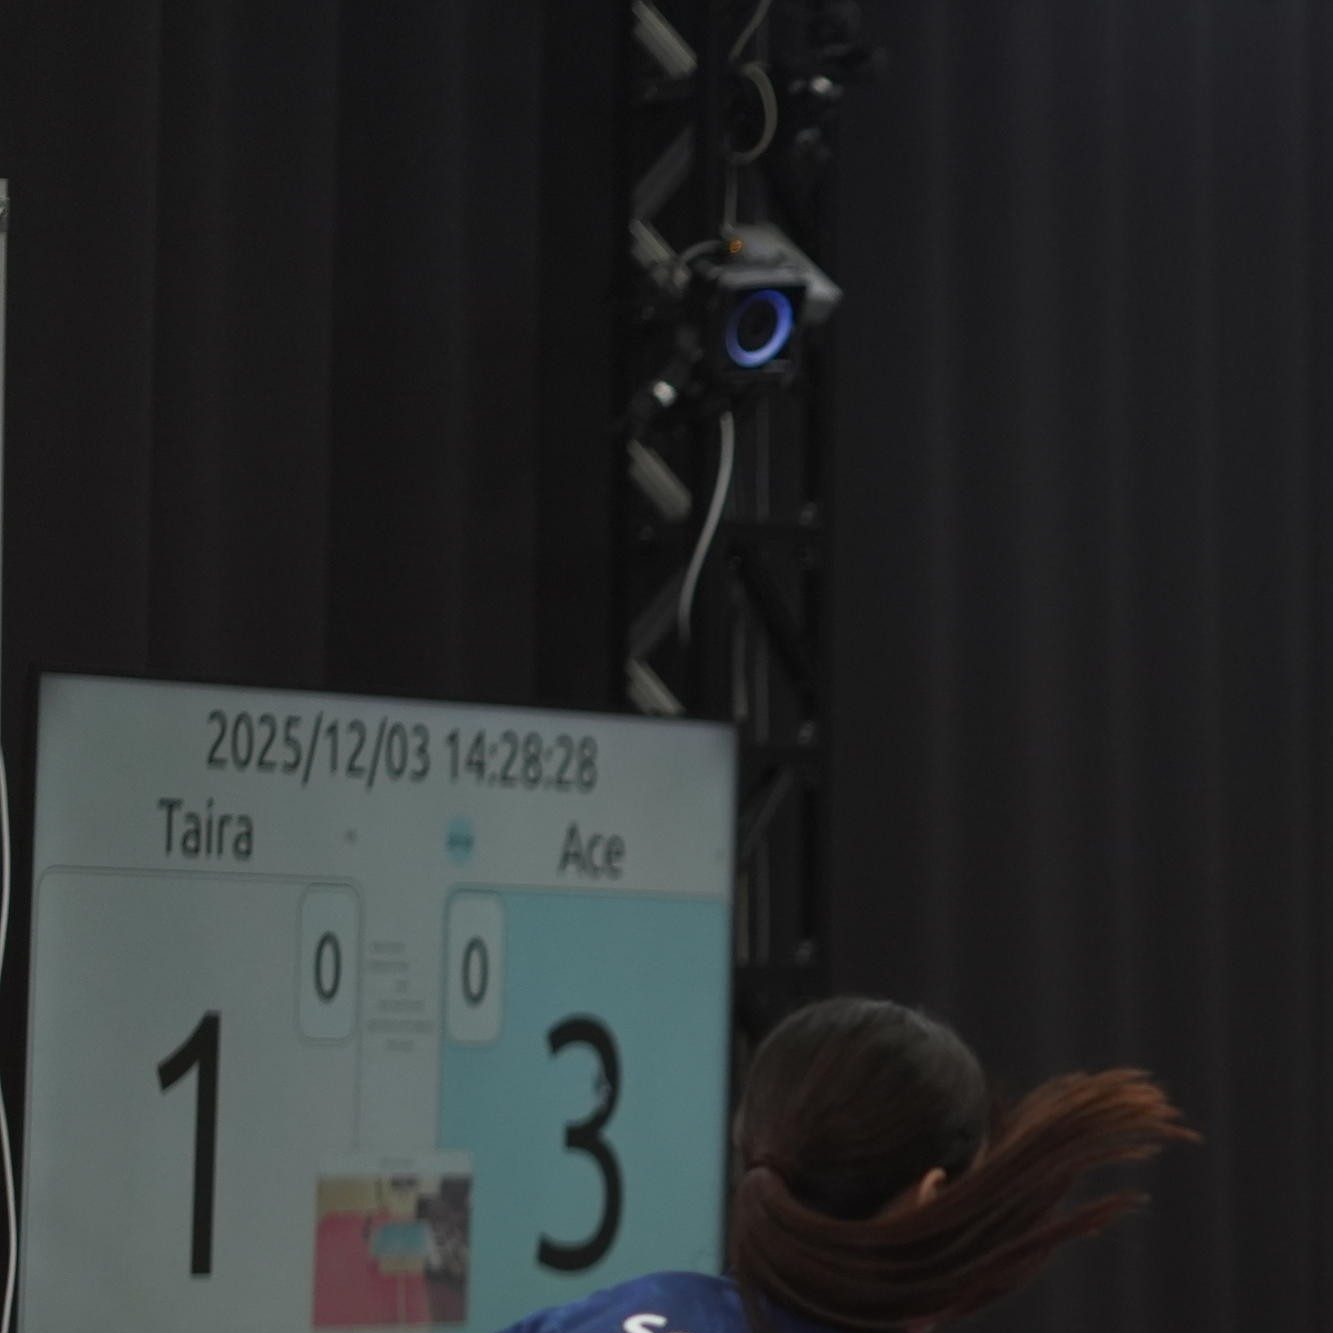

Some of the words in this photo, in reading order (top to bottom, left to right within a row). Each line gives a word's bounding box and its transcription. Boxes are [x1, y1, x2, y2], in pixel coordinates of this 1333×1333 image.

[206, 710, 431, 790] 2025/12/03
[447, 730, 598, 791] 14:28:28
[158, 798, 254, 862] Taira
[558, 823, 627, 880] Ace
[313, 930, 342, 1004] 0
[461, 935, 490, 1008] 0
[156, 1010, 221, 1279] 1
[535, 1013, 625, 1277] 3
